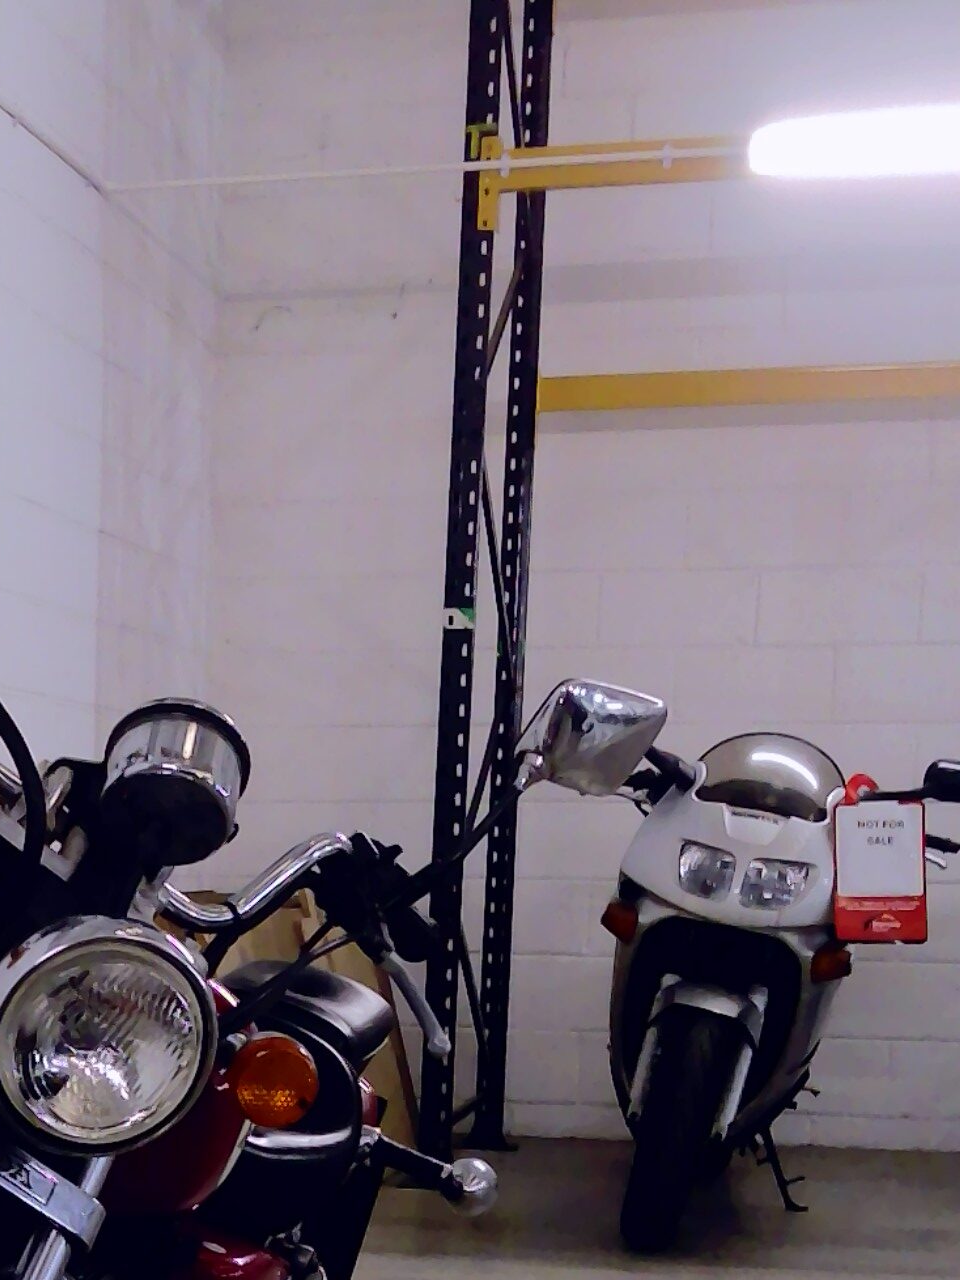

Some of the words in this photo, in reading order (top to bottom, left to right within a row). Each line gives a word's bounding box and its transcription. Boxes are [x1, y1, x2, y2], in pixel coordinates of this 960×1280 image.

[857, 820, 879, 829] NOT
[882, 820, 905, 829] FOR
[867, 836, 894, 846] SALE
